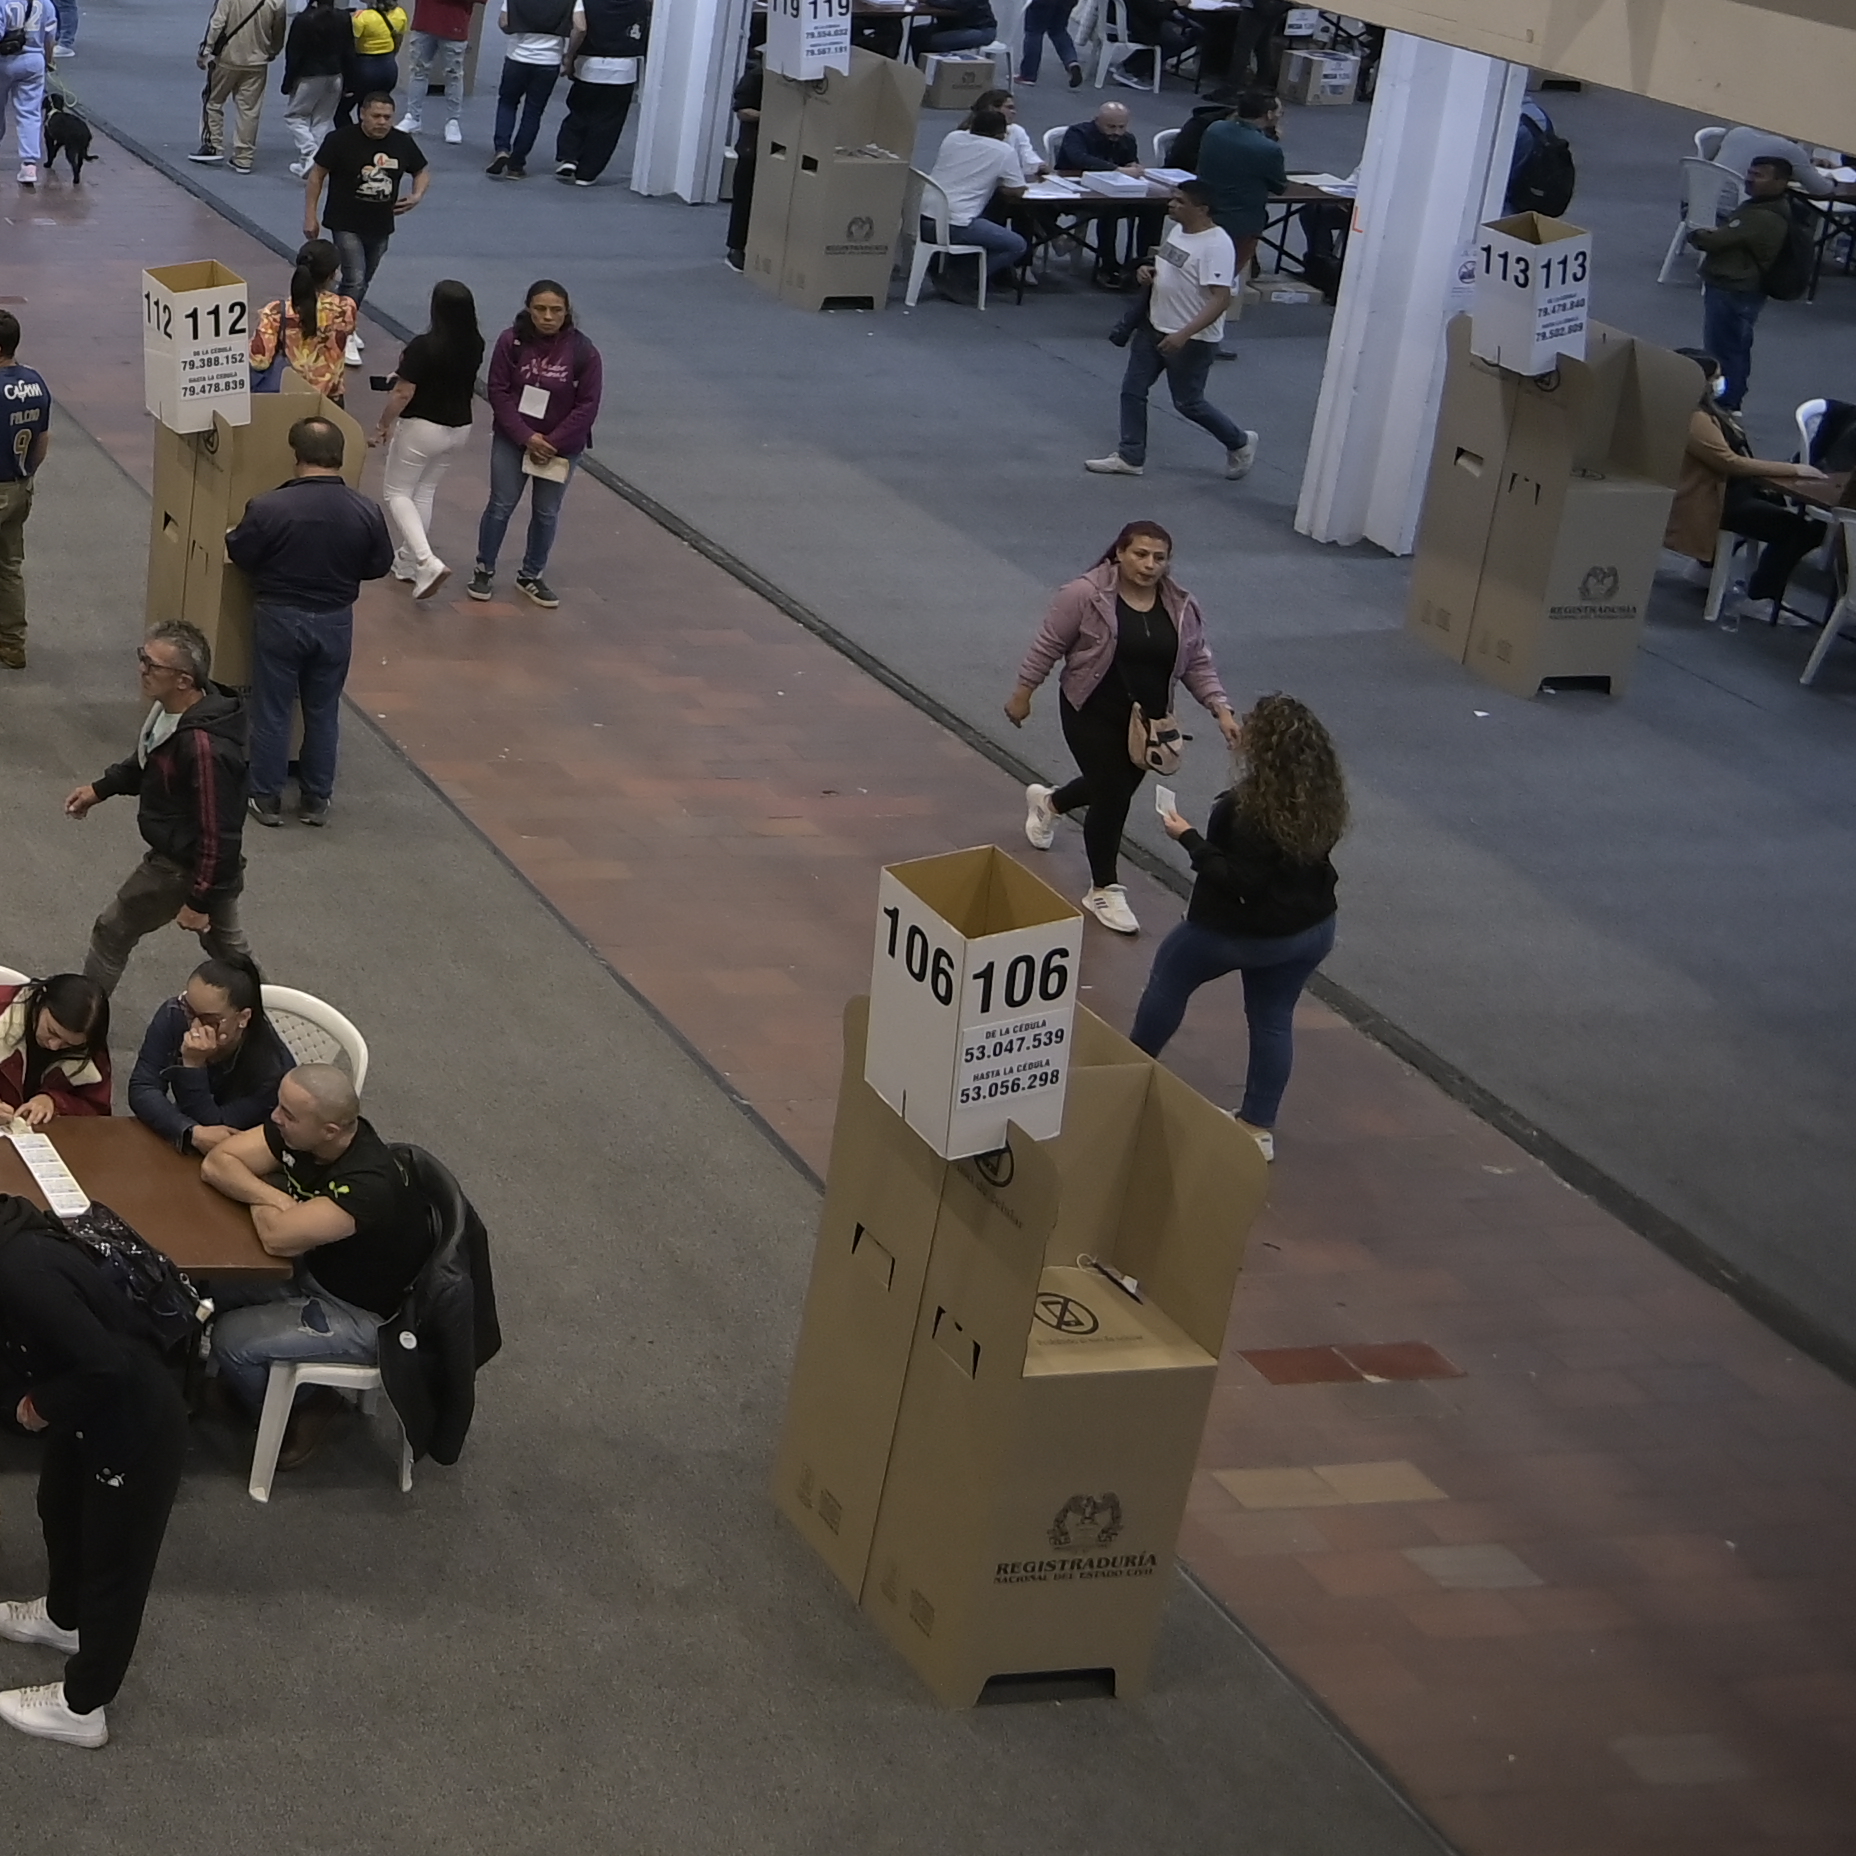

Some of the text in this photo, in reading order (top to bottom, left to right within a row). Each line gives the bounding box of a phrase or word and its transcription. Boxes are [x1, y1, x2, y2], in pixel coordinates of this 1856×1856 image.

[1481, 244, 1530, 290] 113
[1540, 250, 1587, 290] 113
[145, 290, 173, 341] 112
[184, 300, 247, 341] 112
[181, 353, 246, 372] 79.388.152
[182, 379, 246, 398] 79.478.839
[13, 428, 32, 462] 9
[882, 905, 956, 1007] 106
[972, 946, 1070, 1015] 106
[963, 1027, 1066, 1064] 53.047.539
[984, 1018, 1047, 1040] DE LA CÉDULA
[959, 1068, 1061, 1105] 53.056.298
[972, 1057, 1051, 1084] HASTA LA CÉDULA
[995, 1550, 1158, 1576] REGISTRADURÍA
